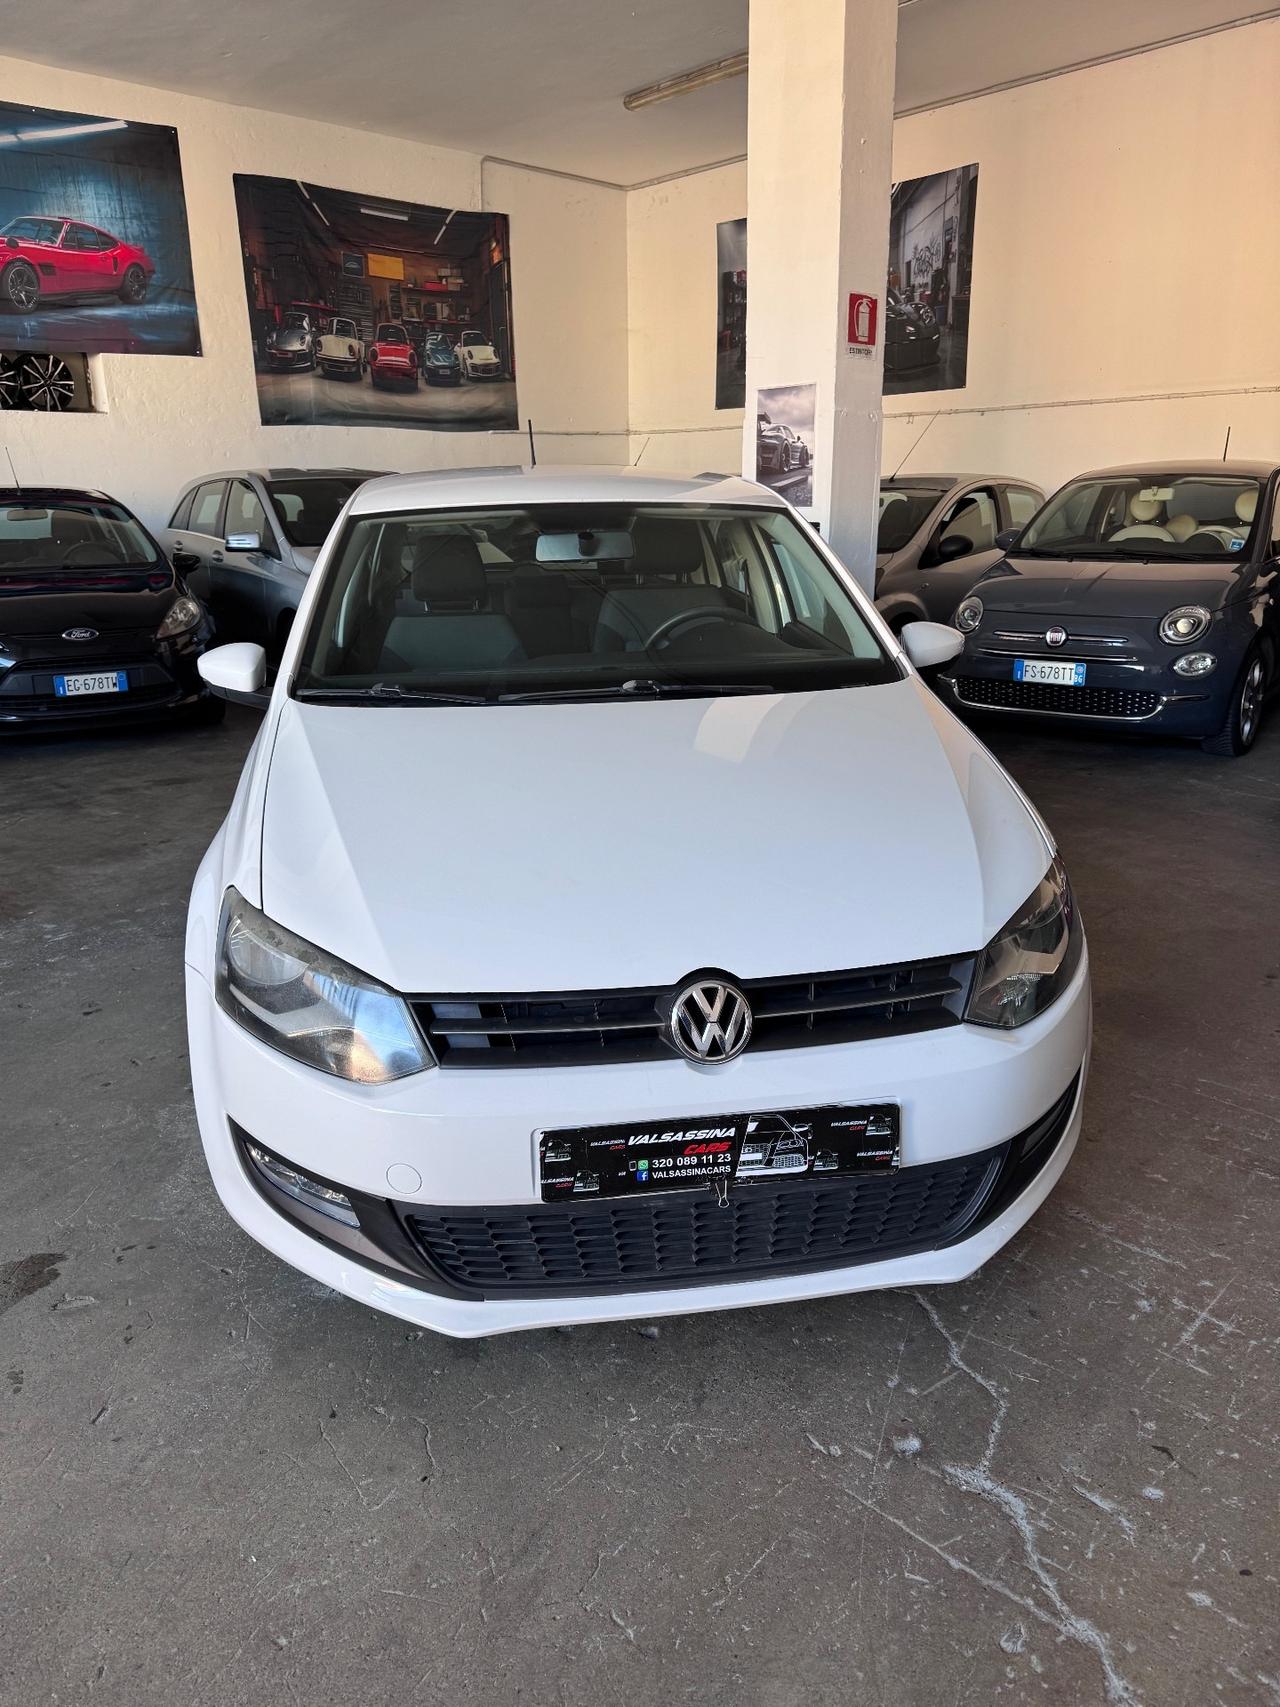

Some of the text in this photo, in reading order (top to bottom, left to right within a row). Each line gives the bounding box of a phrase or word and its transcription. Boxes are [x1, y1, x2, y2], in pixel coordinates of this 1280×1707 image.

[71, 629, 91, 638] Ford
[628, 1127, 736, 1146] VALSASSINA
[683, 1141, 732, 1155] CARS
[652, 1153, 732, 1168] 320 089 11 23
[652, 1165, 732, 1179] VALSASSINACARS
